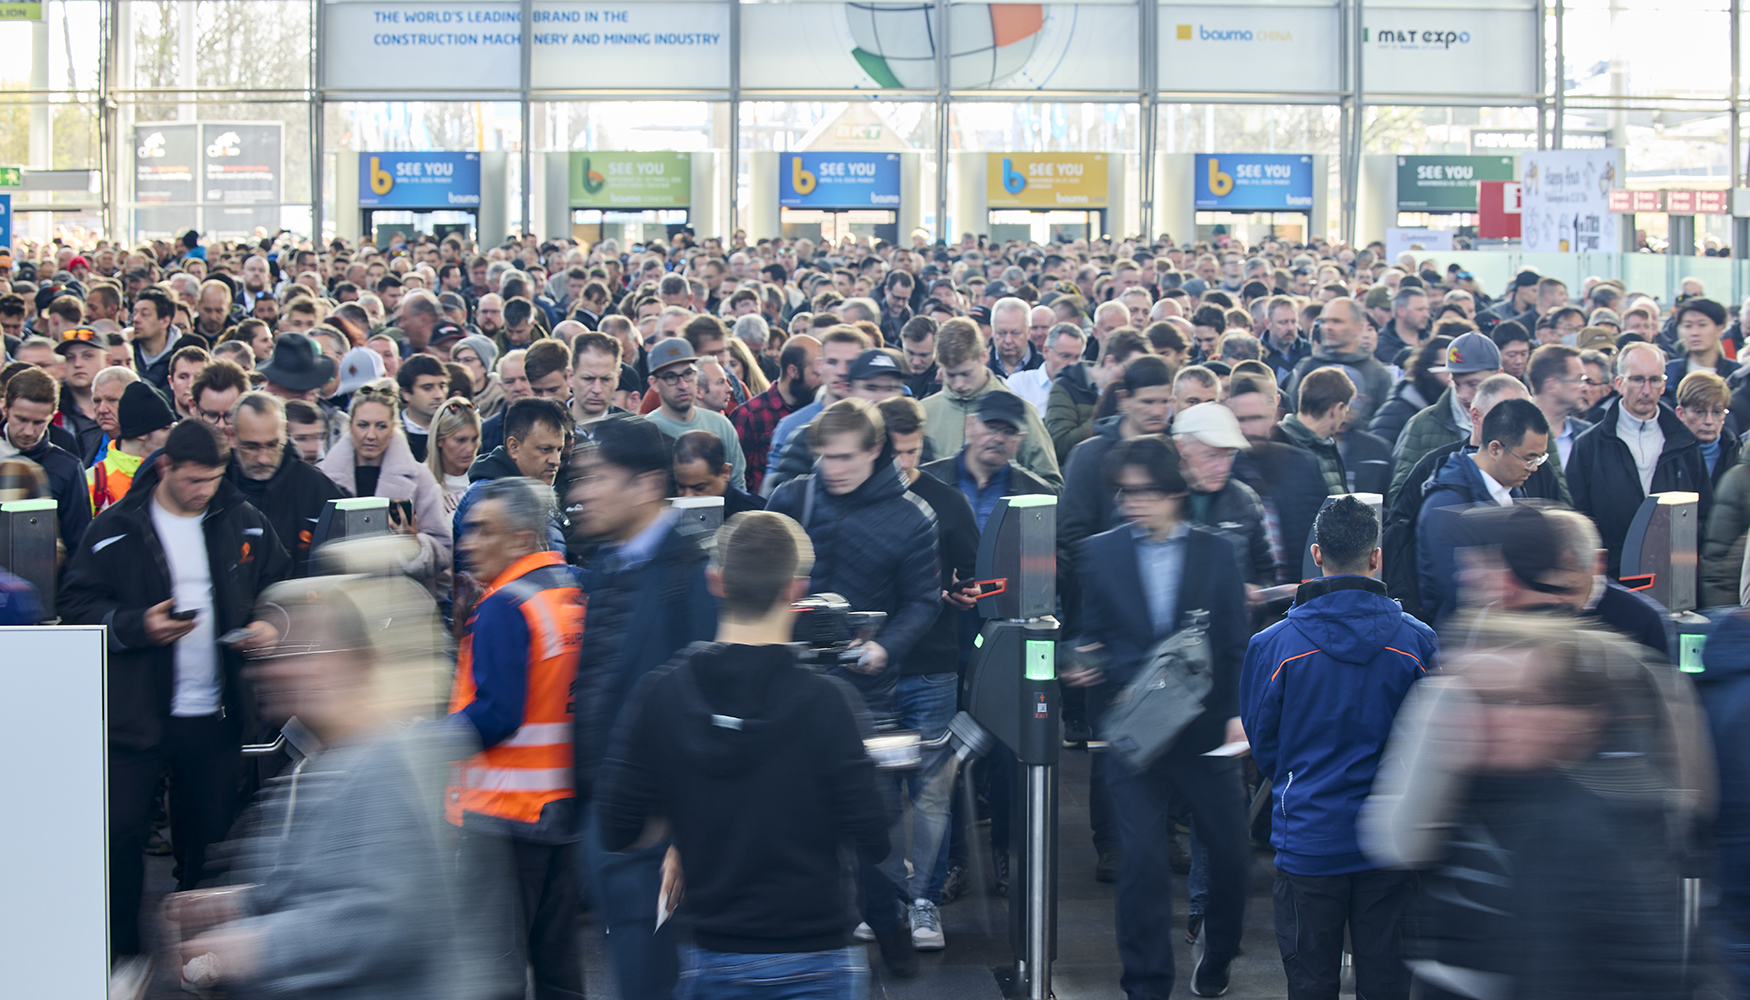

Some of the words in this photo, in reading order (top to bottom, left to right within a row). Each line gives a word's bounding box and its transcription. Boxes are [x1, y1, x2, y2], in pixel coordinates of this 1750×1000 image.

[374, 11, 398, 22] THE
[404, 11, 463, 22] WORLD'S
[533, 11, 580, 22] BRAND
[585, 11, 598, 22] IN
[604, 11, 629, 22] THE
[1200, 24, 1253, 40] bauma
[374, 34, 478, 45] CONSTRUCTION
[483, 34, 567, 45] MACHNERY
[573, 34, 600, 45] AND
[604, 34, 650, 45] MINING
[655, 34, 720, 45] INDUSTRY
[396, 162, 422, 176] SEE
[424, 162, 453, 176] YOU
[608, 162, 633, 175] SEE
[637, 162, 664, 175] YOU
[820, 163, 845, 176] SEE
[848, 163, 876, 176] YOU
[1029, 163, 1054, 176] SEE
[1057, 163, 1084, 176] YOU
[1236, 164, 1262, 178] SEE
[1264, 164, 1291, 178] YOU
[1417, 166, 1442, 179] SEE
[1445, 166, 1473, 179] YOU
